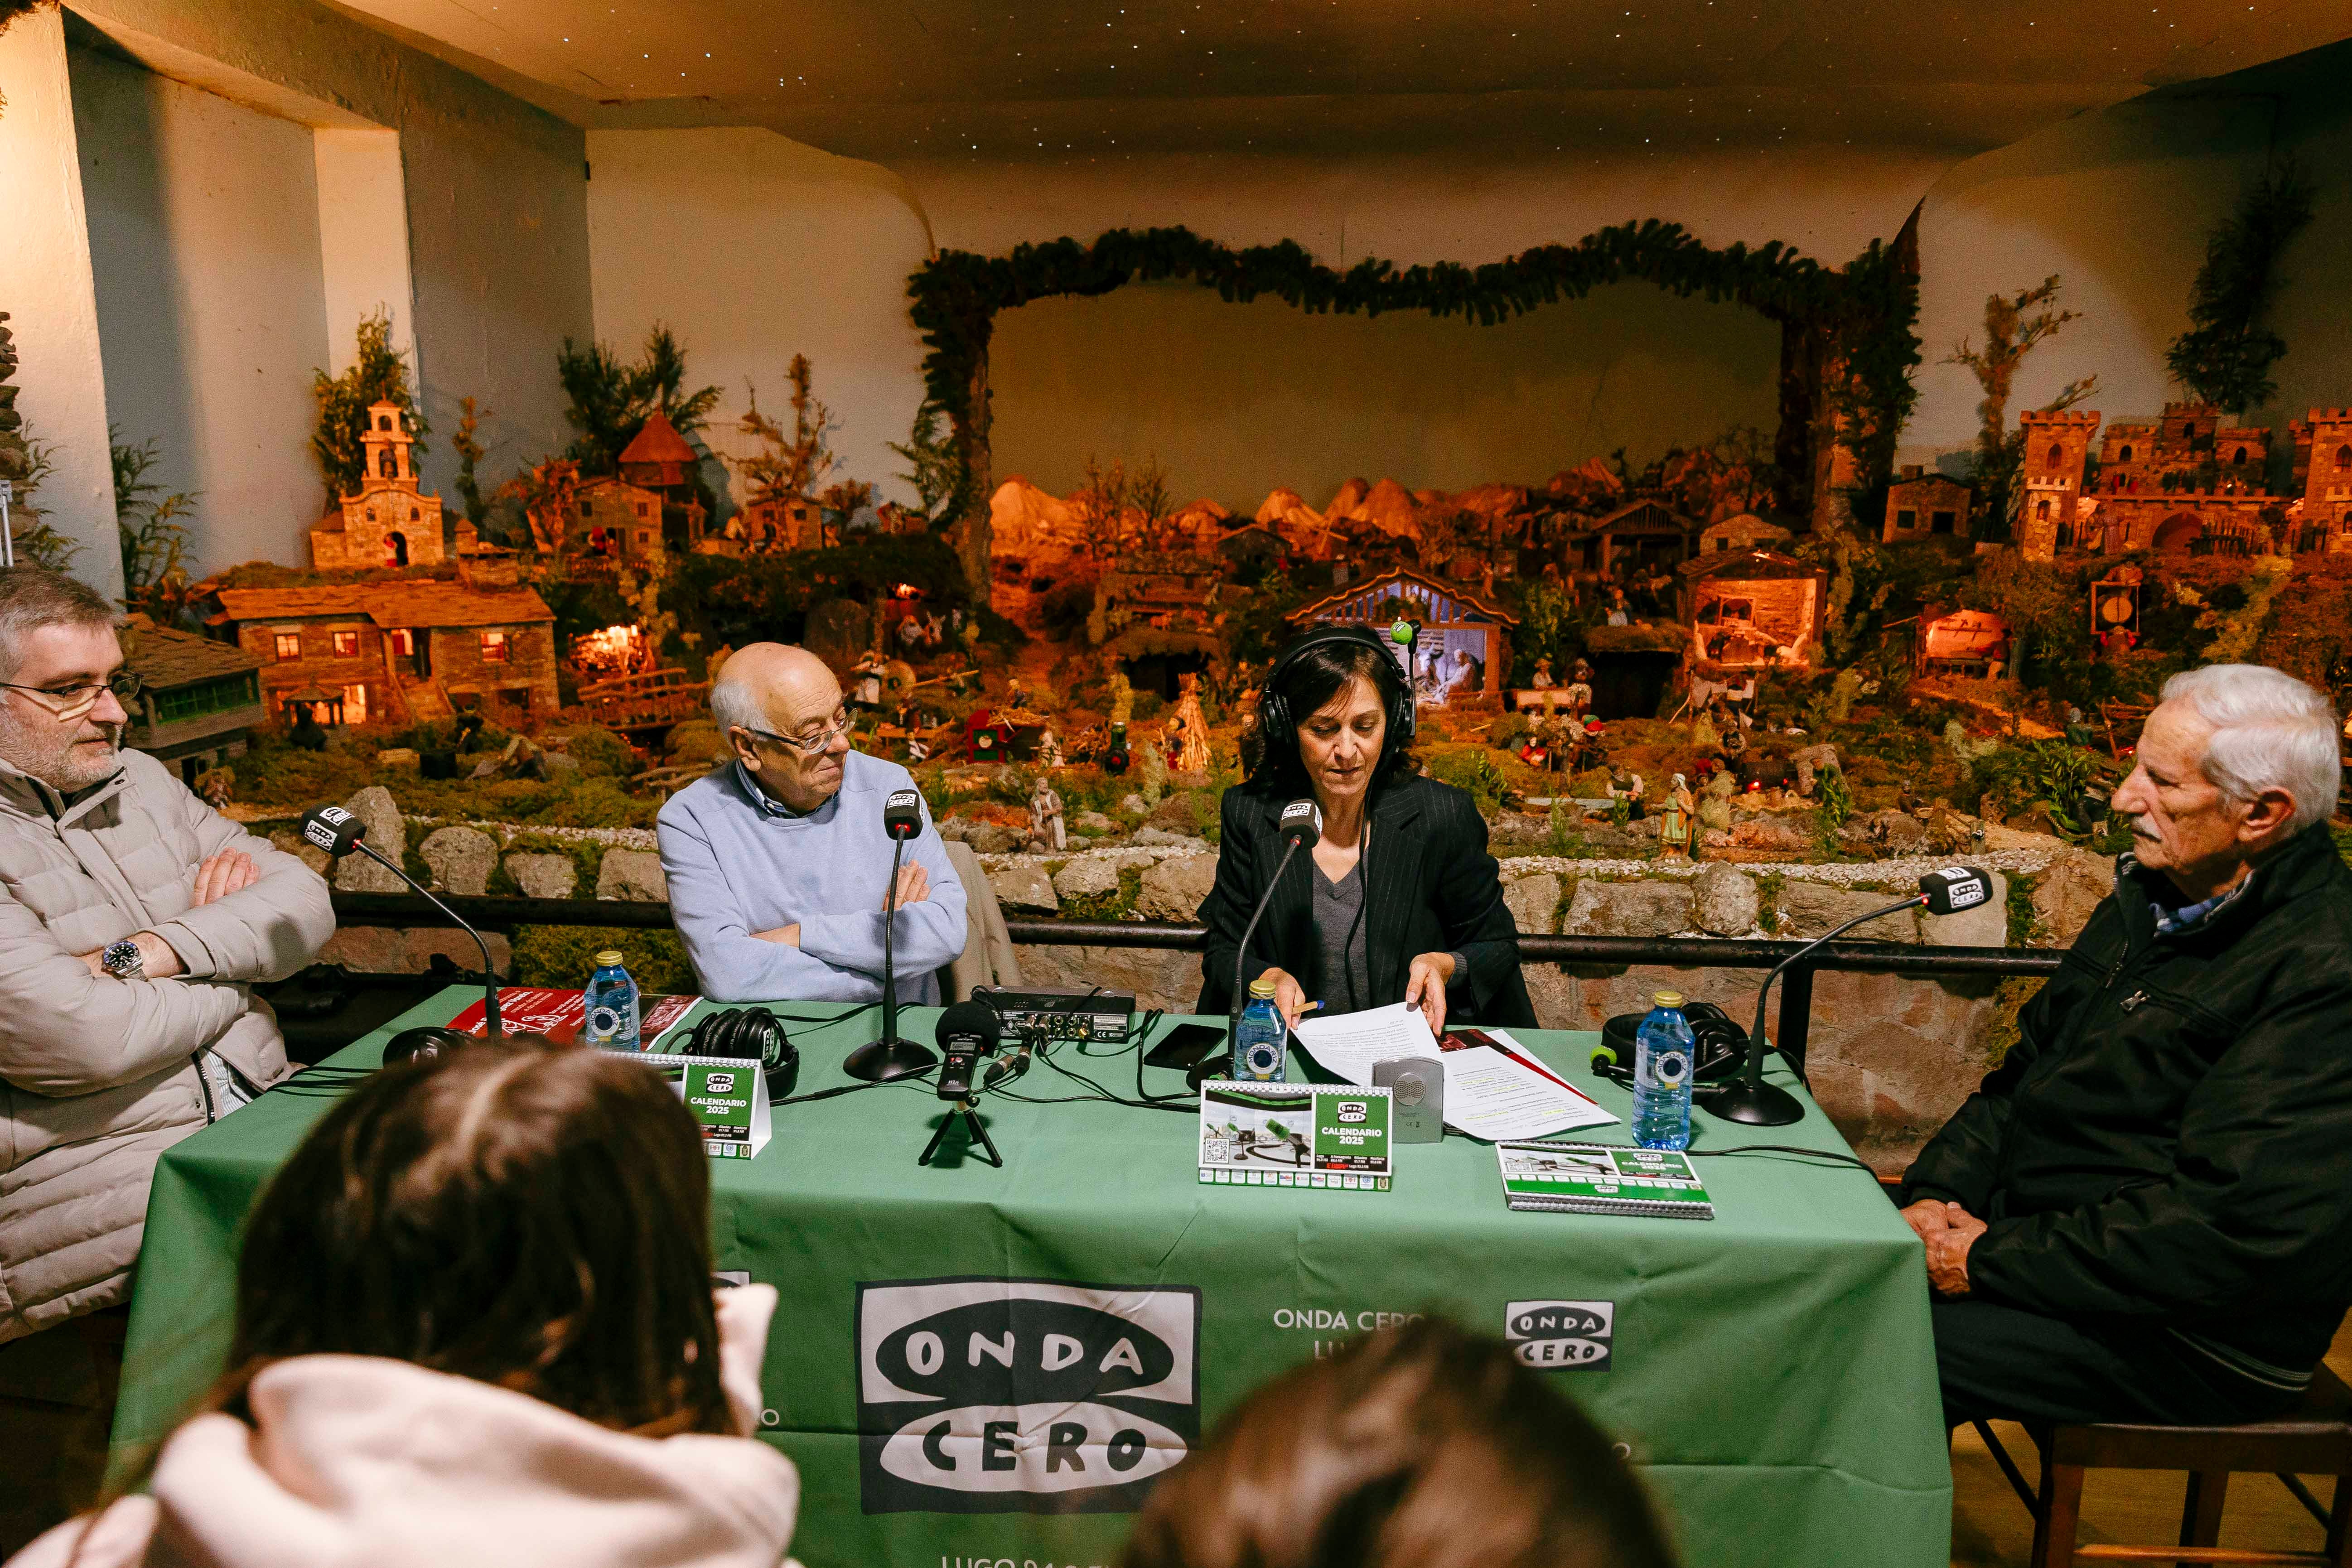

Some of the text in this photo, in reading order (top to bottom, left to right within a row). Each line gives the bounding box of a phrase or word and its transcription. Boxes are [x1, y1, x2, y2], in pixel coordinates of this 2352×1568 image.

[311, 825, 330, 839] ONDA
[591, 1008, 618, 1026] MONDARIZ
[1249, 1044, 1277, 1063] MONDARIZ
[1658, 1053, 1686, 1072] MONDARIZ
[690, 1097, 747, 1107] CALENDARIO
[706, 1106, 729, 1114] 2025
[1322, 1127, 1382, 1137] CALENDARIO
[1339, 1136, 1364, 1145] 2025
[1273, 1309, 1349, 1330] ONDA
[1520, 1316, 1596, 1331] ONDA
[905, 1330, 1143, 1375] ONDA
[1523, 1344, 1595, 1361] CERO
[922, 1420, 1146, 1473] CERO
